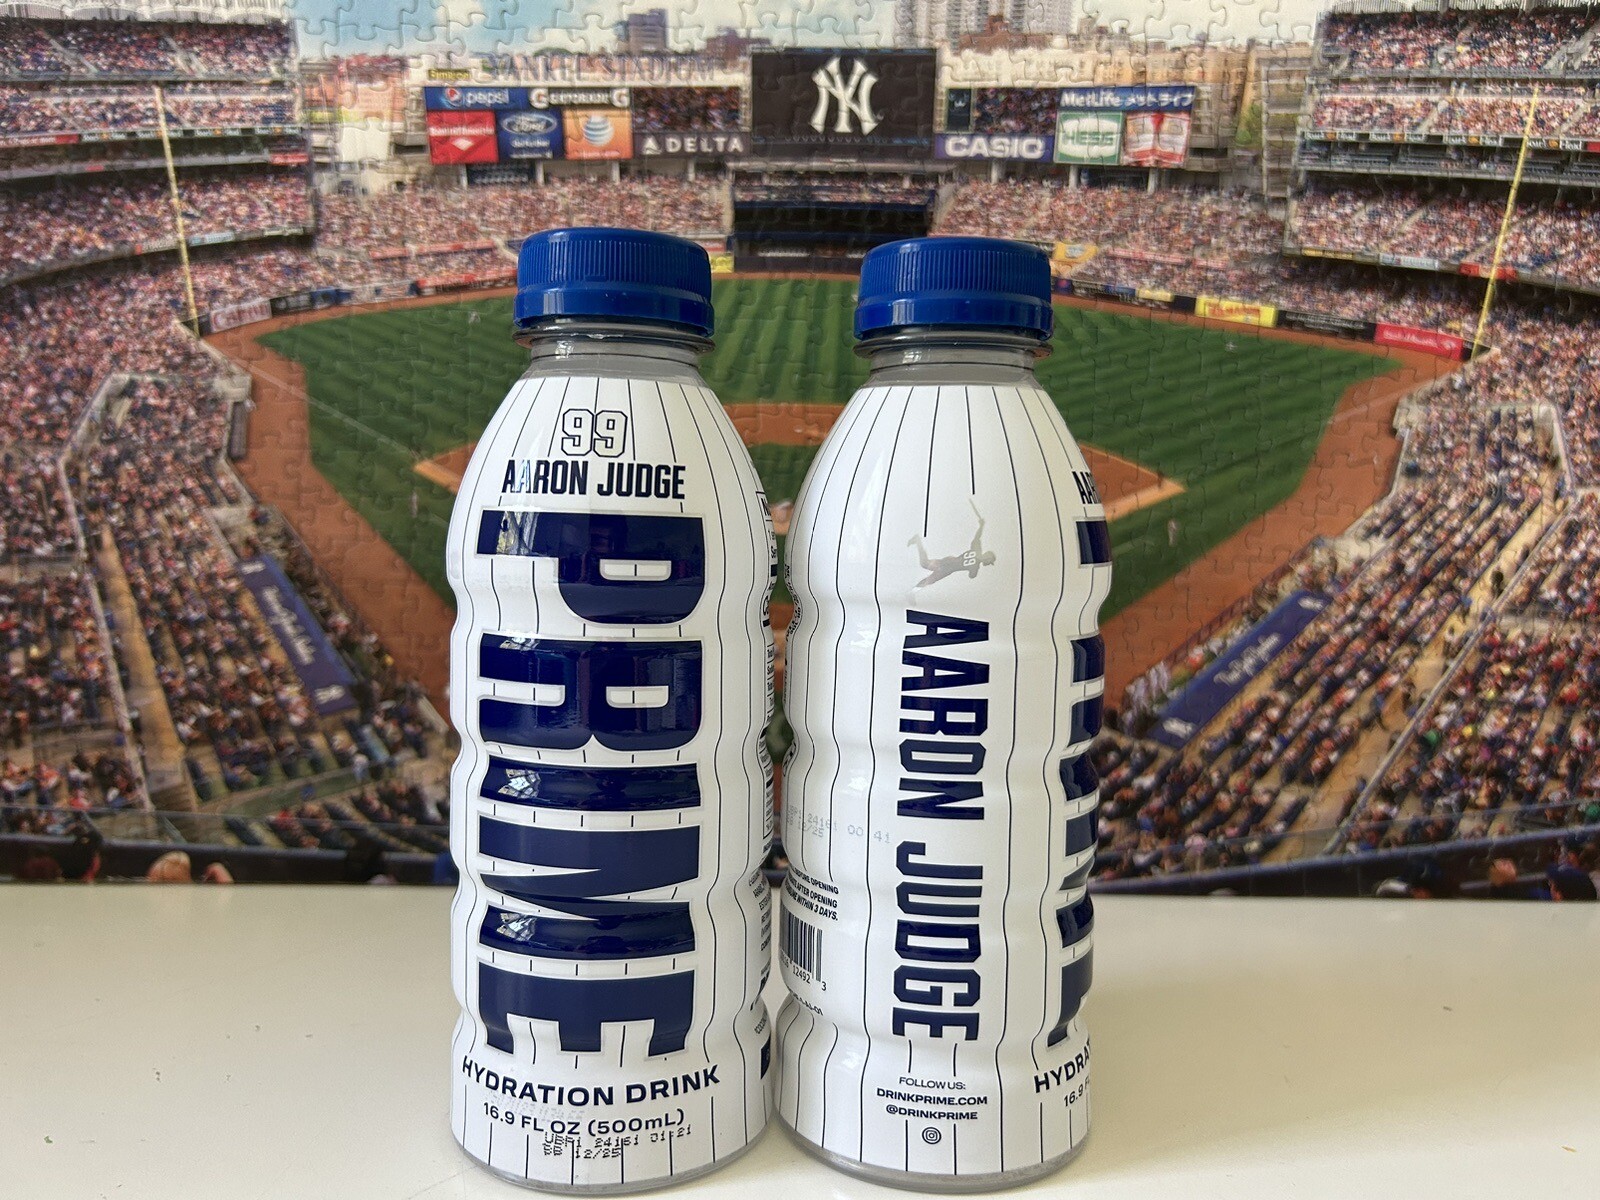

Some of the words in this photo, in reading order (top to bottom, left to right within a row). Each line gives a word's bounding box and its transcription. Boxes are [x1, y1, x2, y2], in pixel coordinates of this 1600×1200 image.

[466, 88, 509, 107] pepsi
[1061, 89, 1120, 108] MetLife
[664, 136, 744, 153] DELTA
[944, 136, 1046, 160] CASIO
[560, 408, 628, 458] 99
[501, 458, 588, 496] AARON
[597, 463, 686, 500] JUDGE
[896, 608, 990, 820] AARON
[475, 510, 706, 1057] PRIME
[810, 877, 839, 895] OPENING
[796, 895, 814, 911] WITHIN
[814, 904, 819, 914] 3
[819, 906, 839, 921] DAYS.
[810, 891, 838, 909] OPENING
[892, 840, 984, 1041] JUDGE
[821, 981, 827, 992] 3
[462, 1054, 613, 1107] HYDRATION
[626, 1064, 721, 1103] DRINK
[899, 1076, 946, 1090] FOLLOW
[947, 1080, 966, 1090] US:
[876, 1088, 988, 1106] DRINKPRIME.COM
[1063, 1084, 1084, 1107] 16.9
[483, 1102, 515, 1125] 16.9
[521, 1115, 544, 1133] FL
[551, 1120, 580, 1135] OZ
[587, 1108, 684, 1137] (500mL)
[886, 1104, 978, 1120] @DRINKPRIME
[576, 1147, 622, 1159] 12/25
